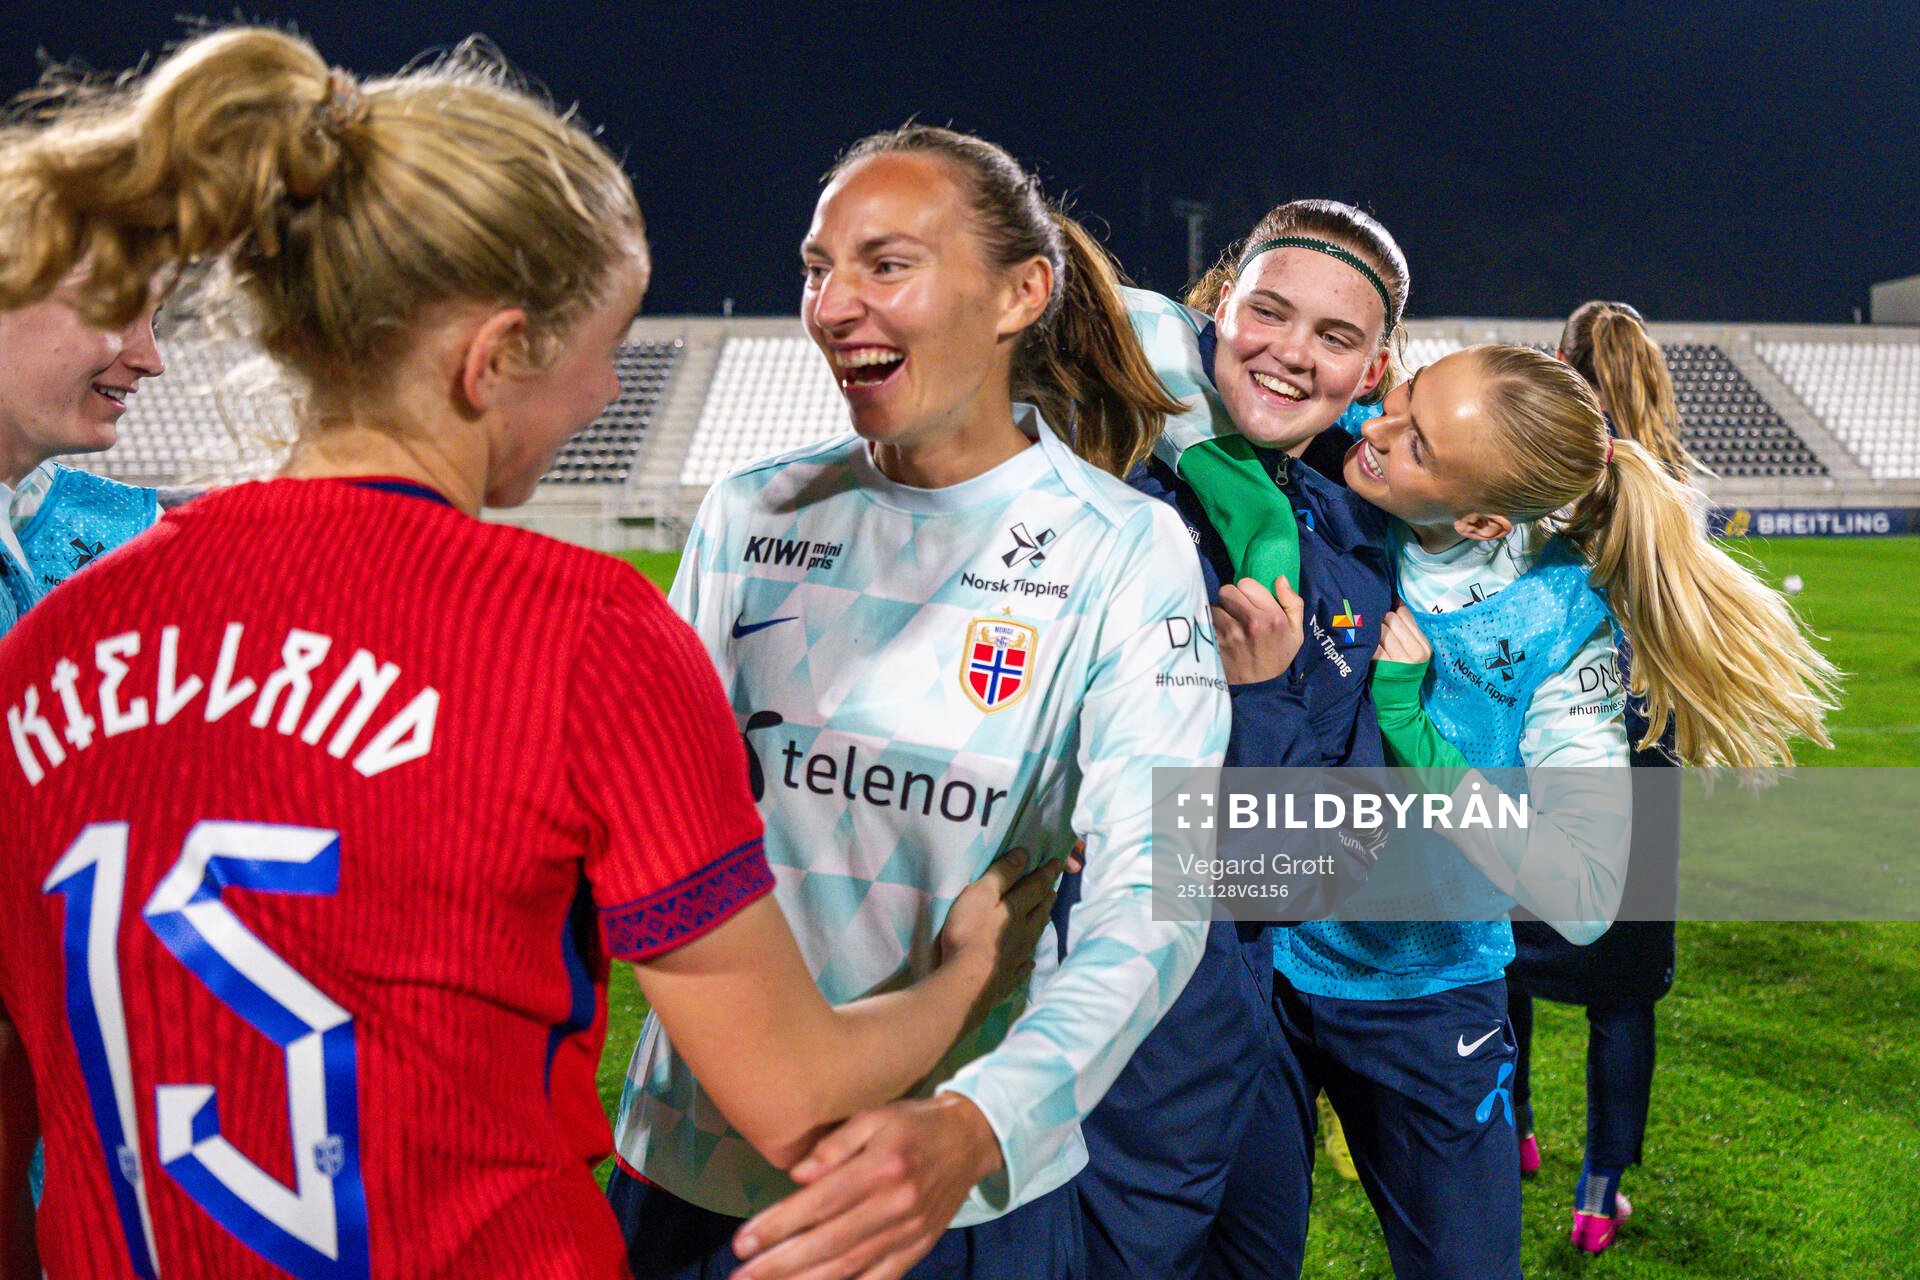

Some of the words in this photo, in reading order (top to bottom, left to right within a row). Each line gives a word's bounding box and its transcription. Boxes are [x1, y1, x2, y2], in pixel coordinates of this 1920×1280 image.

[1757, 512, 1890, 535] BREITLING
[743, 536, 810, 567] KIWI
[807, 556, 833, 571] pris
[812, 542, 843, 557] mini
[960, 573, 1010, 593] Norsk
[1013, 578, 1069, 598] Tipping
[1321, 635, 1352, 678] Tipping
[1454, 657, 1483, 687] Norsk
[7, 622, 440, 786] KIELLAND
[782, 740, 1008, 828] telenor
[42, 820, 372, 1280] 15
